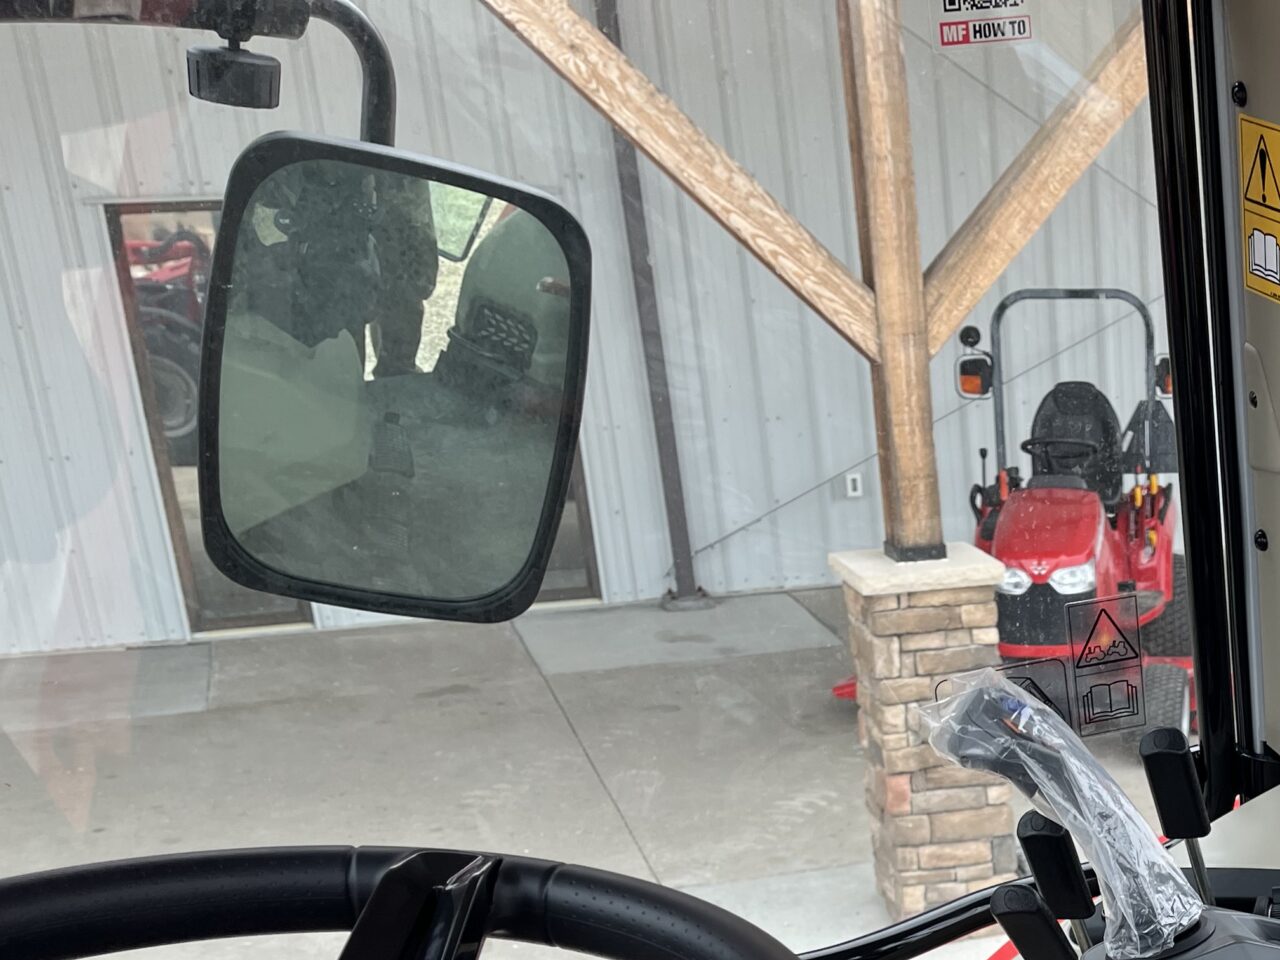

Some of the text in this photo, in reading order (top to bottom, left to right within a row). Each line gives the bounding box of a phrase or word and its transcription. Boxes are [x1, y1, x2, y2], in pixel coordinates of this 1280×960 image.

[942, 20, 1026, 43] MF HOW TO
